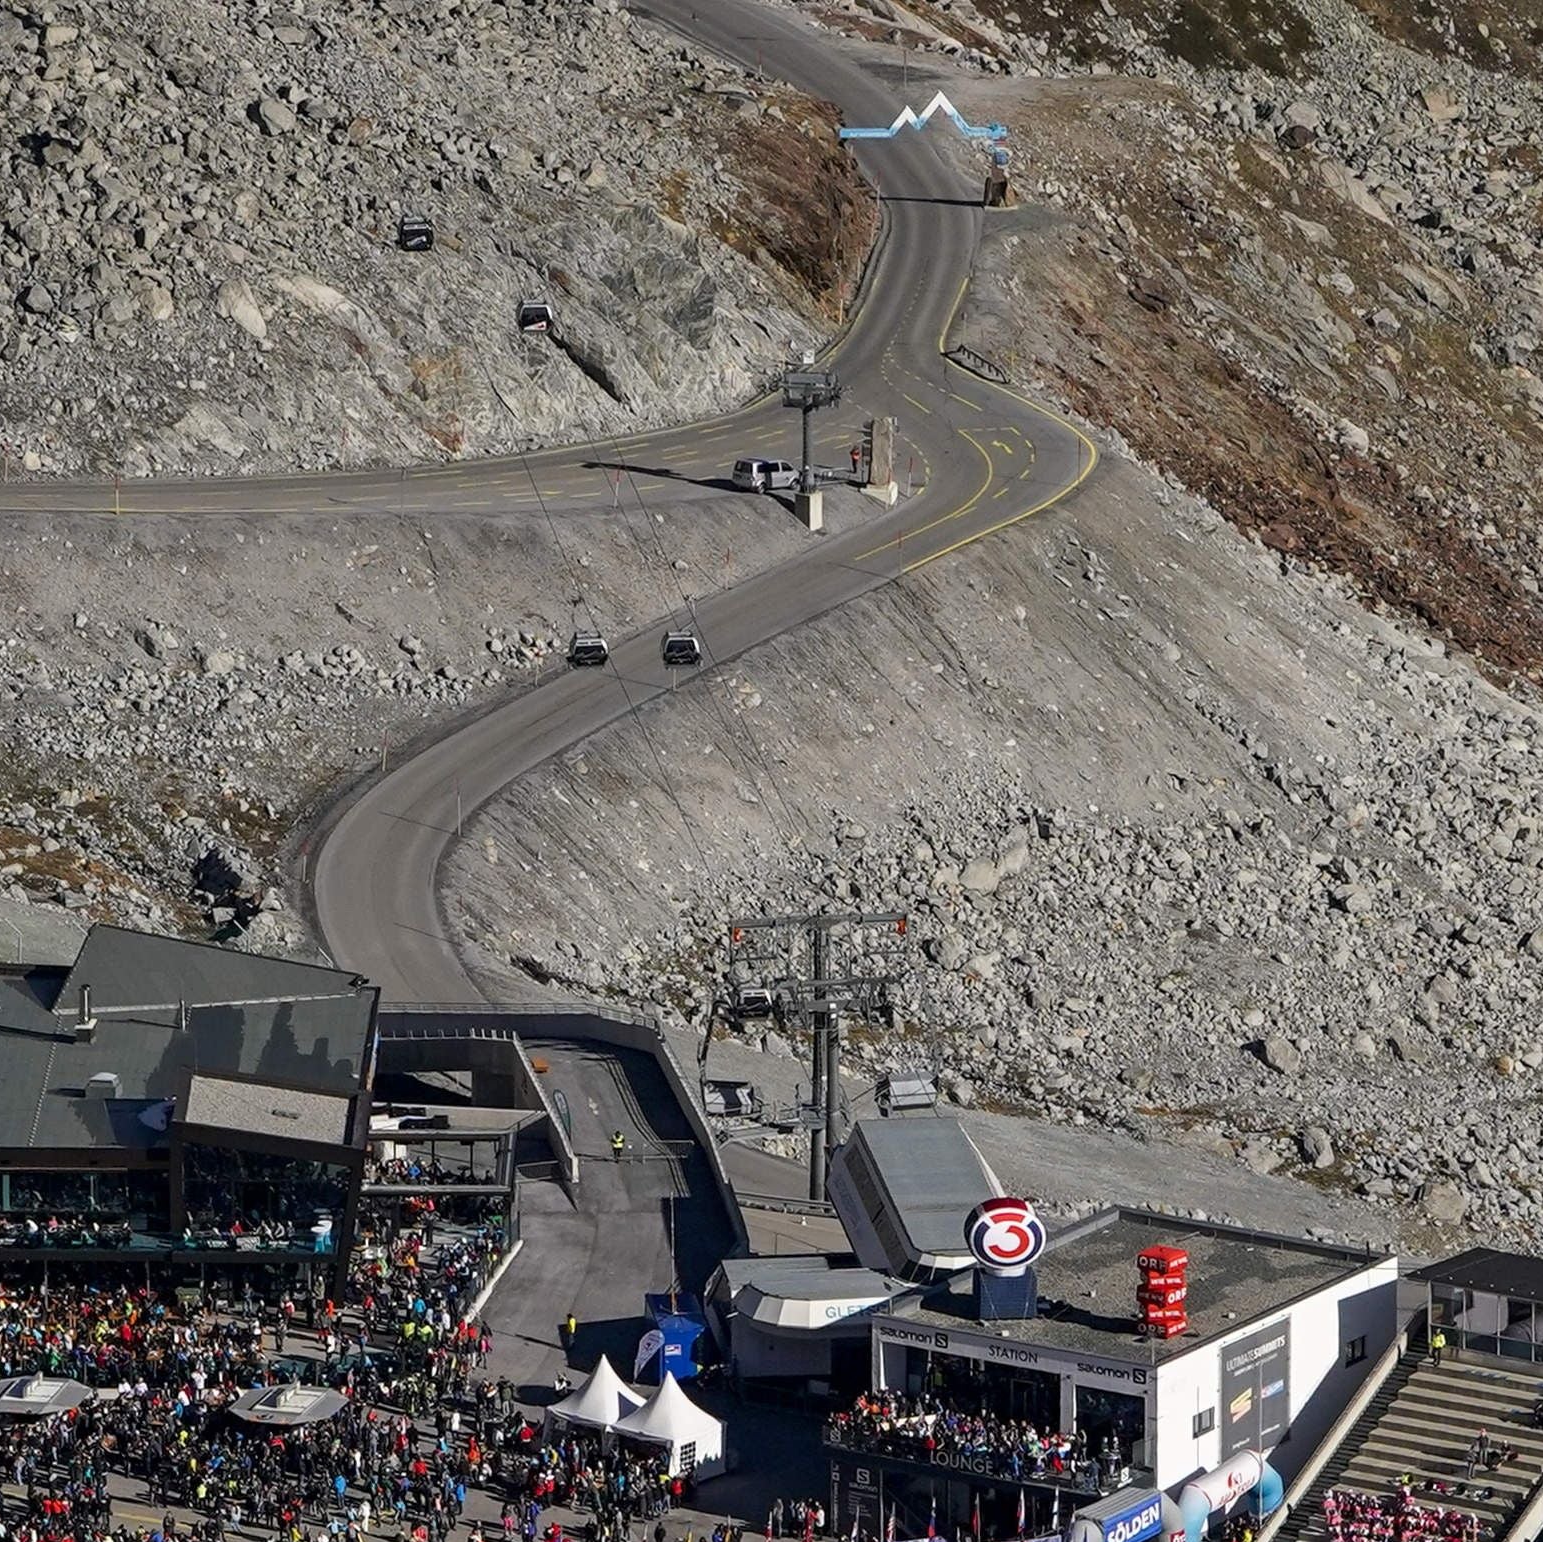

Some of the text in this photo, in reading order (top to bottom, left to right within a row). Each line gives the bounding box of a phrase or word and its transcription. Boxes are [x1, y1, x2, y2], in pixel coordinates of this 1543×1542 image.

[1139, 1255, 1168, 1271] ORF
[1168, 1287, 1187, 1304] ORF
[880, 1326, 932, 1345] salomon
[988, 1344, 1038, 1364] STATION
[1077, 1361, 1130, 1380] salomon
[930, 1450, 994, 1476] LOUNGE
